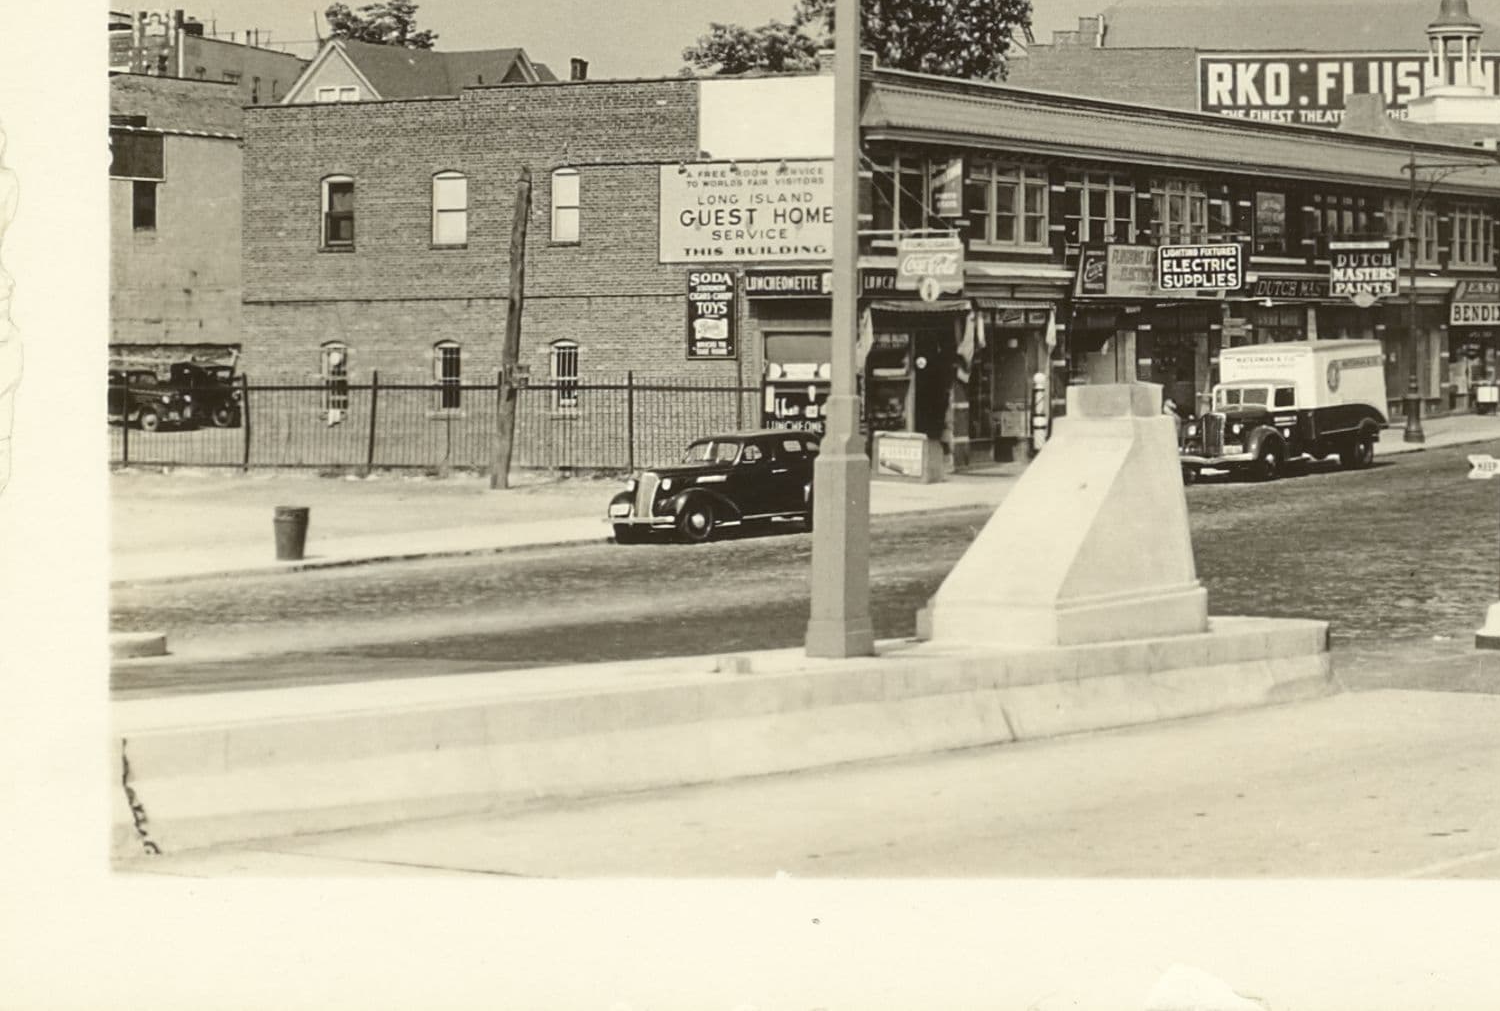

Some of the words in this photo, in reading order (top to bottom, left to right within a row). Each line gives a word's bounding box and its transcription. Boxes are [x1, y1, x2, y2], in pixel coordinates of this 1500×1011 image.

[1250, 109, 1294, 122] FINEST
[1299, 110, 1345, 123] THEAT
[697, 170, 726, 179] FREE
[735, 169, 768, 178] ROOM
[776, 167, 824, 177] SERVICE
[686, 180, 698, 189] TO
[748, 178, 768, 187] FAIR
[775, 177, 825, 186] VISITORS
[697, 194, 740, 206] LONG
[750, 192, 814, 204] ISLAND
[680, 208, 758, 227] GUEST
[774, 206, 833, 225] HOME
[712, 228, 788, 241] SERVICE
[683, 247, 724, 257] THIS
[735, 245, 827, 256] BUILDING
[1162, 248, 1199, 257] LIGHTING
[1201, 247, 1237, 257] FIXTURES
[1162, 258, 1237, 273] ELECTRIC
[1337, 253, 1392, 267] DUTCH
[689, 272, 734, 286] SODA
[1163, 273, 1238, 288] SUPPLIES
[1333, 267, 1396, 281] MASTERS
[746, 275, 819, 291] LUNCHEONETTE
[1256, 280, 1297, 296] DUTCH
[1335, 282, 1392, 294] PAINTS
[696, 301, 728, 315] TOYS
